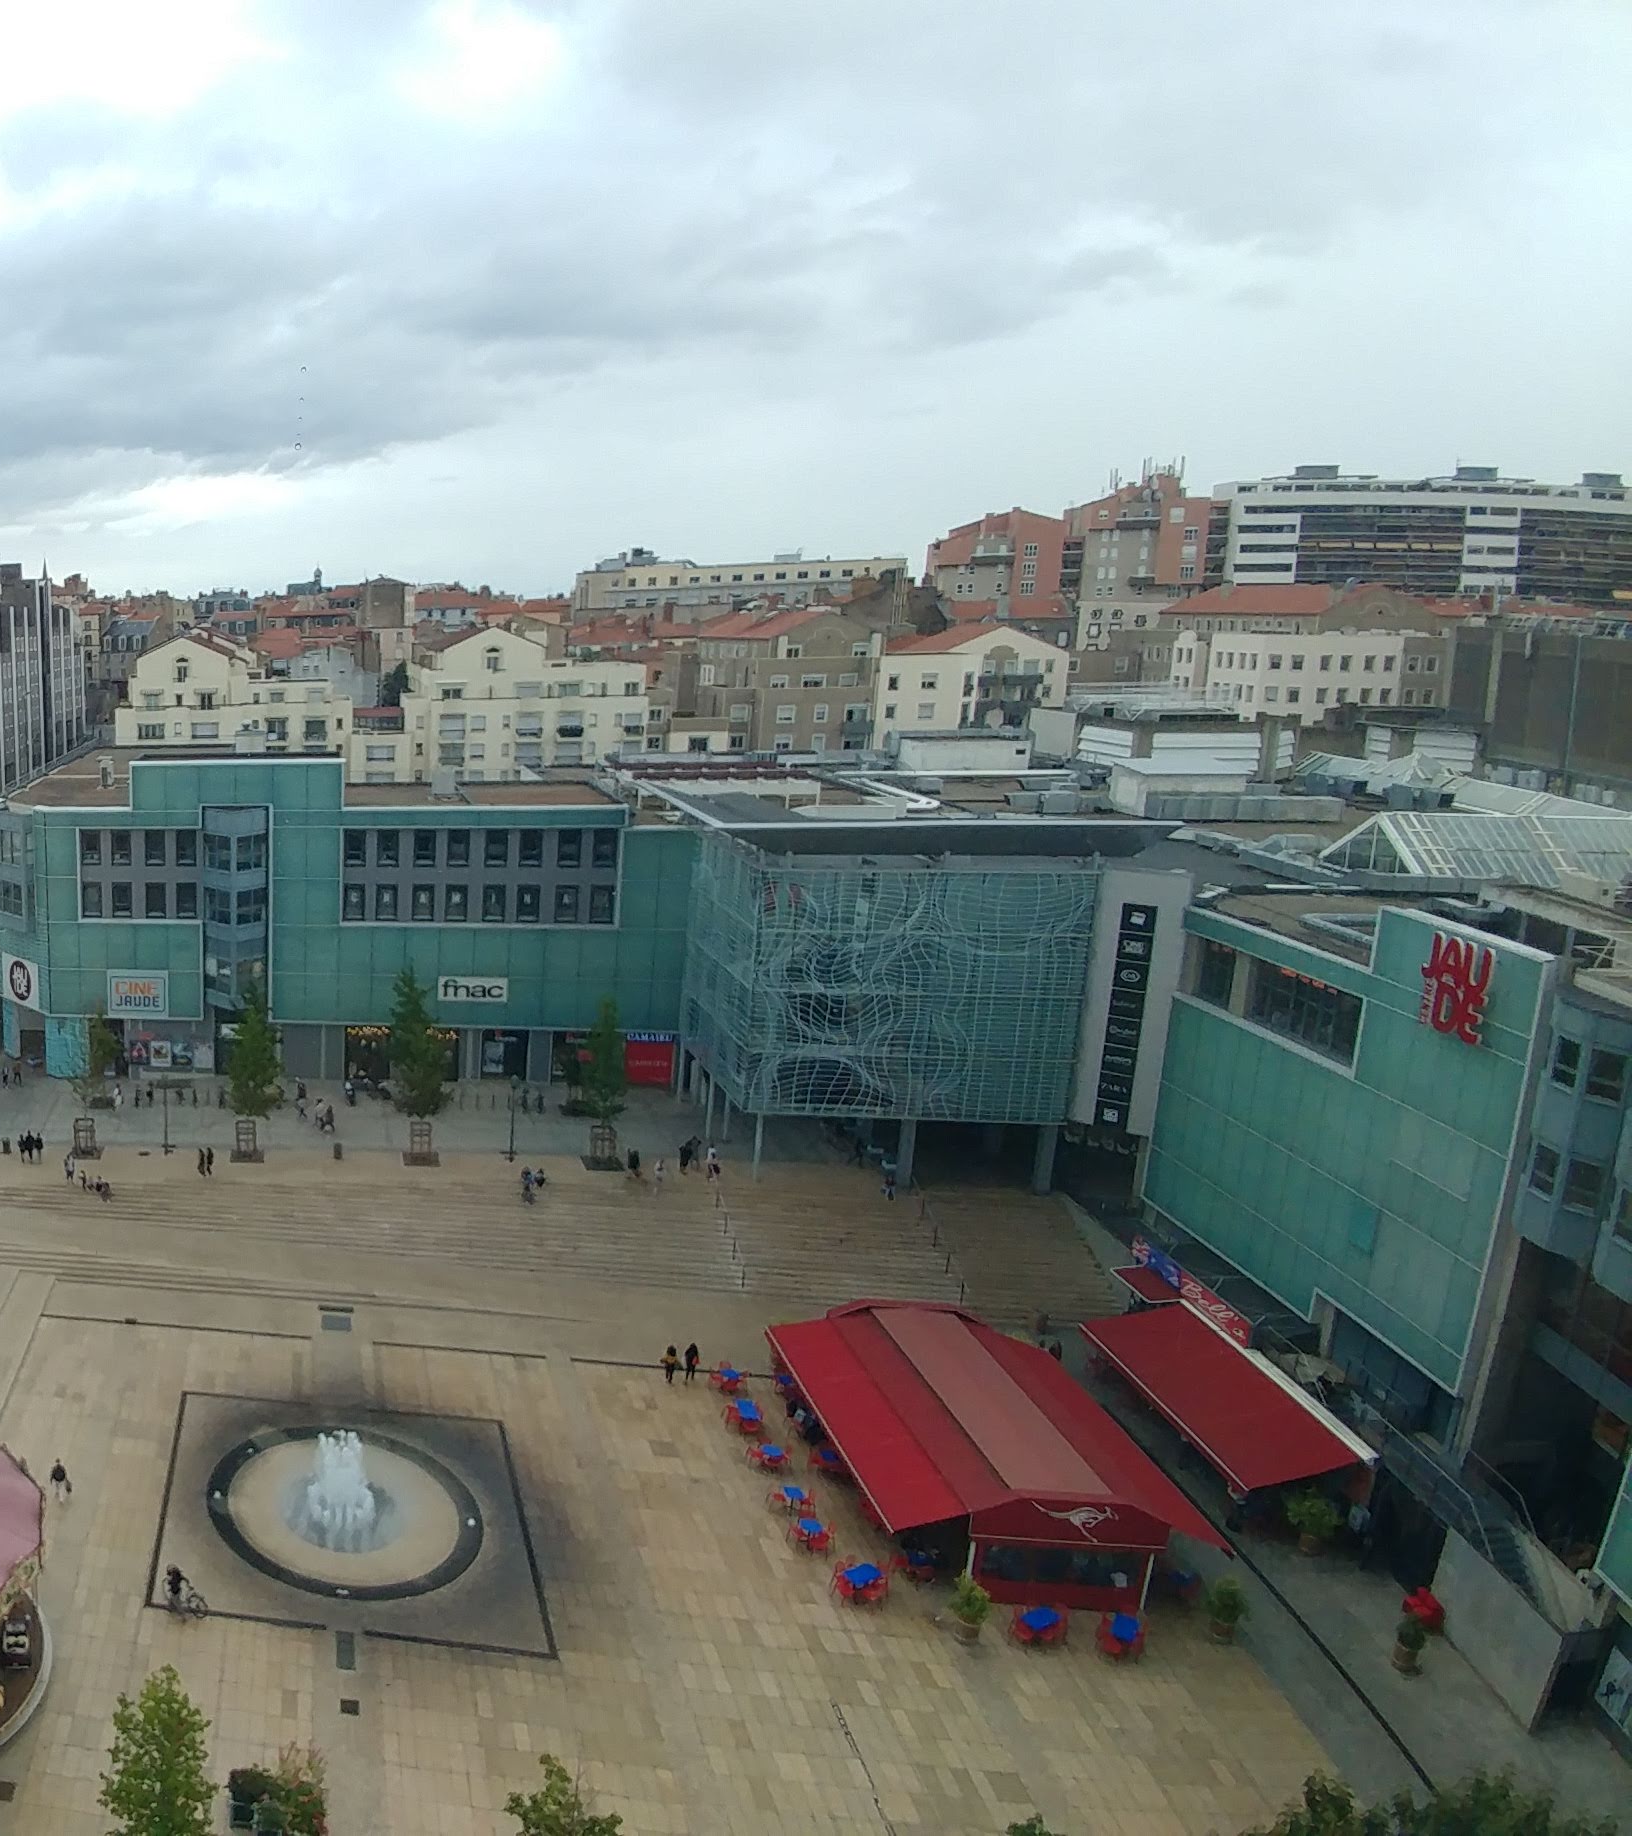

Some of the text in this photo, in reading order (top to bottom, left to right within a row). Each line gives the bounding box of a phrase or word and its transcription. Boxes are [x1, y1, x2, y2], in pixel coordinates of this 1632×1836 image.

[115, 981, 160, 995] CINE
[441, 979, 504, 998] fnac
[115, 995, 160, 1008] JAUDE
